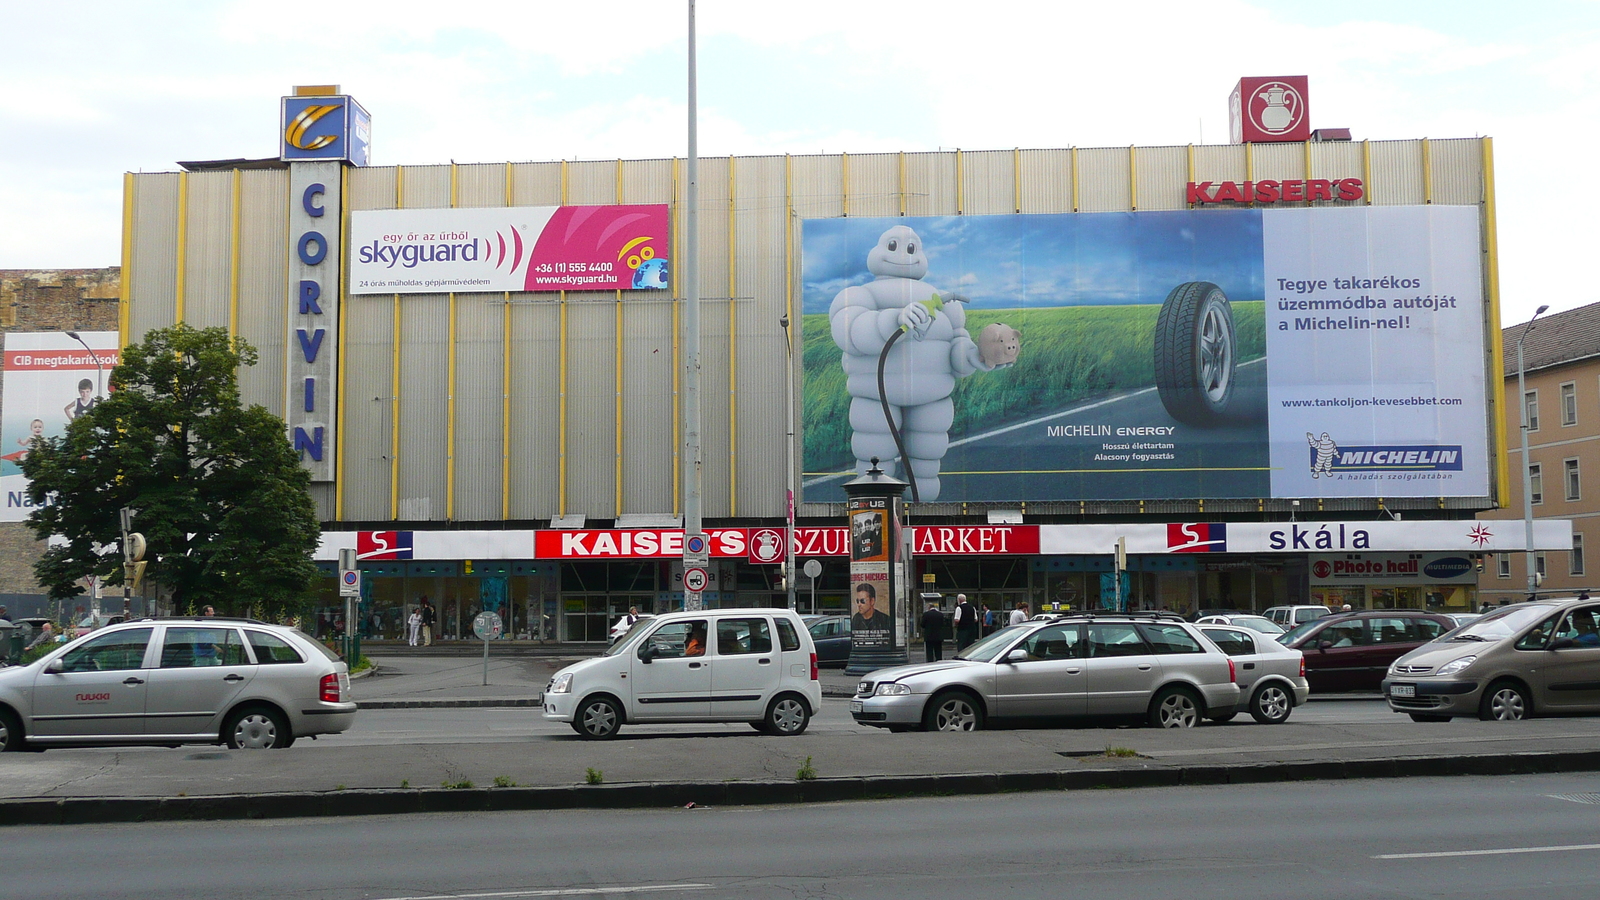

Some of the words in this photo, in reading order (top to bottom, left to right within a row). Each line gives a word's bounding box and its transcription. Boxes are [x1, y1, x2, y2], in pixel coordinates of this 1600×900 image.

[1186, 178, 1364, 203] KAISER'S
[383, 234, 403, 243] egy
[407, 232, 419, 241] őr
[423, 233, 435, 241] az
[439, 231, 469, 241] űrből
[359, 238, 479, 268] skyguard
[535, 263, 552, 273] +36
[555, 263, 567, 273] (1)
[569, 262, 587, 272] 555
[589, 262, 613, 272] 4400
[359, 280, 369, 288] 24
[370, 279, 386, 287] órás
[388, 278, 423, 287] műholdas
[425, 278, 491, 288] gépjárművédelem
[536, 274, 618, 285] www.skyguard.hu
[1277, 278, 1328, 294] Tegye
[1333, 275, 1421, 290] takarékos
[1278, 296, 1387, 311] üzemmódba
[1393, 294, 1457, 312] autóját
[293, 182, 328, 462] CORVIN
[1278, 319, 1289, 331] a
[1295, 315, 1411, 331] Michelin-nel!
[13, 355, 32, 366] CIB
[1282, 396, 1463, 408] www.tankoljon-kevesebbet.com
[1047, 425, 1111, 437] MICHELIN
[1116, 426, 1175, 436] ENERGY
[1102, 442, 1130, 451] Hosszú
[1132, 441, 1175, 450] élettartam
[1094, 453, 1130, 462] Alacsony
[1132, 452, 1175, 461] fogyasztás
[1340, 450, 1458, 465] MICHELIN
[1347, 473, 1383, 481] haladás
[1387, 472, 1453, 482] szolgálatában
[870, 500, 885, 508] U2
[794, 527, 1012, 555] SZUARKET
[1269, 523, 1371, 550] skála
[1334, 560, 1383, 574] Photo
[1387, 559, 1419, 573] hall
[1426, 563, 1471, 571] MULTIMEDIA
